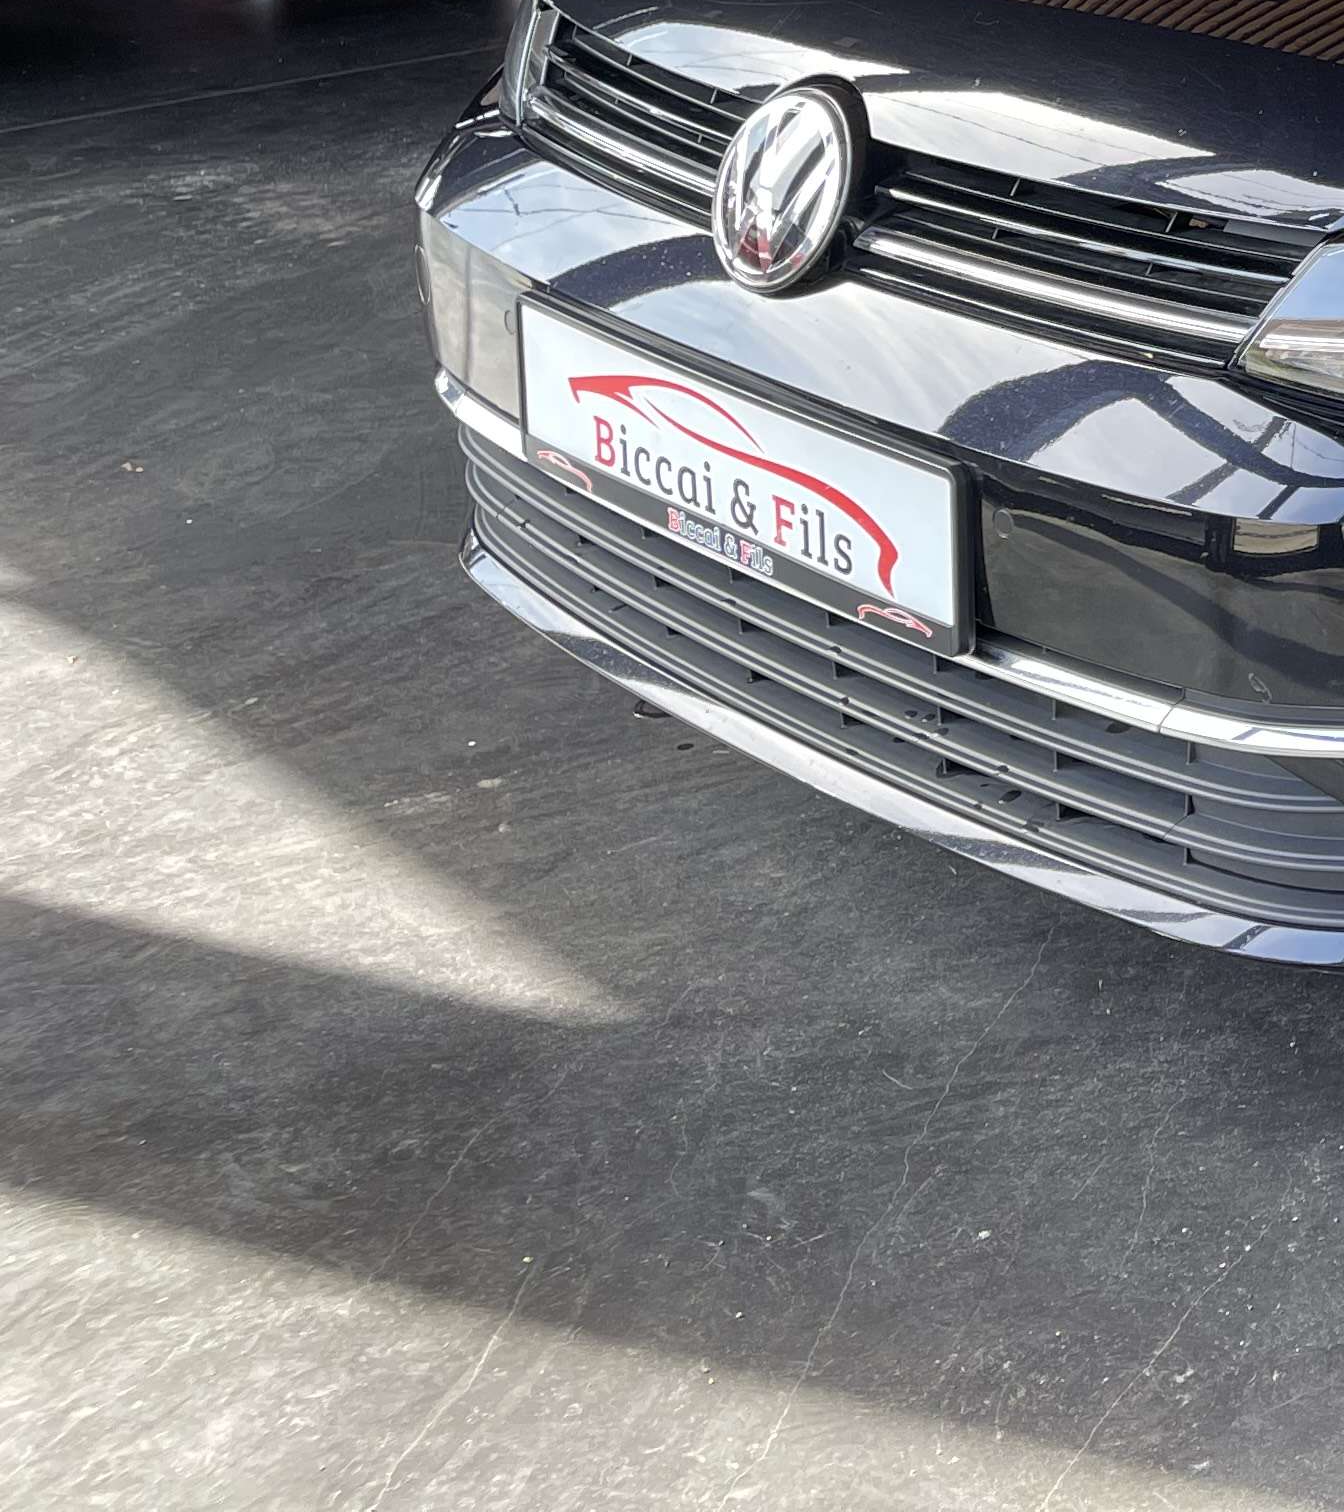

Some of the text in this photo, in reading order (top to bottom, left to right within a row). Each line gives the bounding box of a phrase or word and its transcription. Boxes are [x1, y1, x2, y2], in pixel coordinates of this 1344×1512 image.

[592, 414, 853, 576] Biccai & Fils
[666, 506, 775, 577] Biccai & Fils
